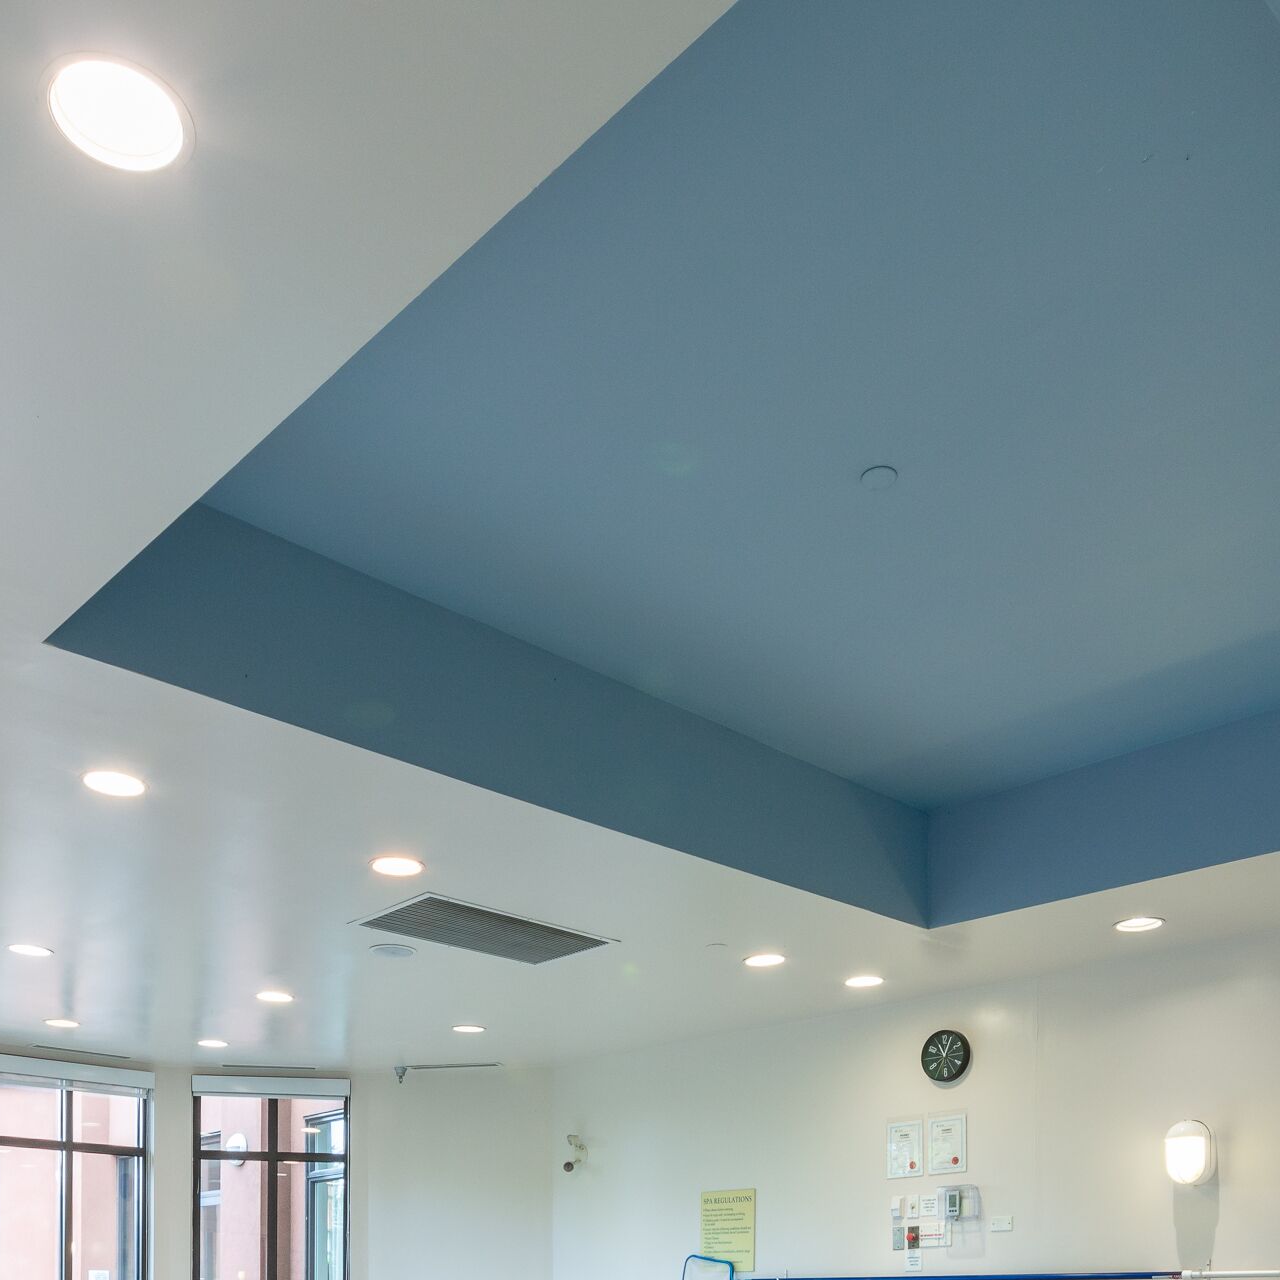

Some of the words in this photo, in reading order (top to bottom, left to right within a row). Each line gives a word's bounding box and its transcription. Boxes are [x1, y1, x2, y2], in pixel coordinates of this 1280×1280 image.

[942, 1034, 948, 1044] 12
[928, 1045, 938, 1054] 10
[952, 1042, 961, 1050] 2
[943, 1068, 948, 1078] 6
[714, 1195, 752, 1204] REGULATIONS
